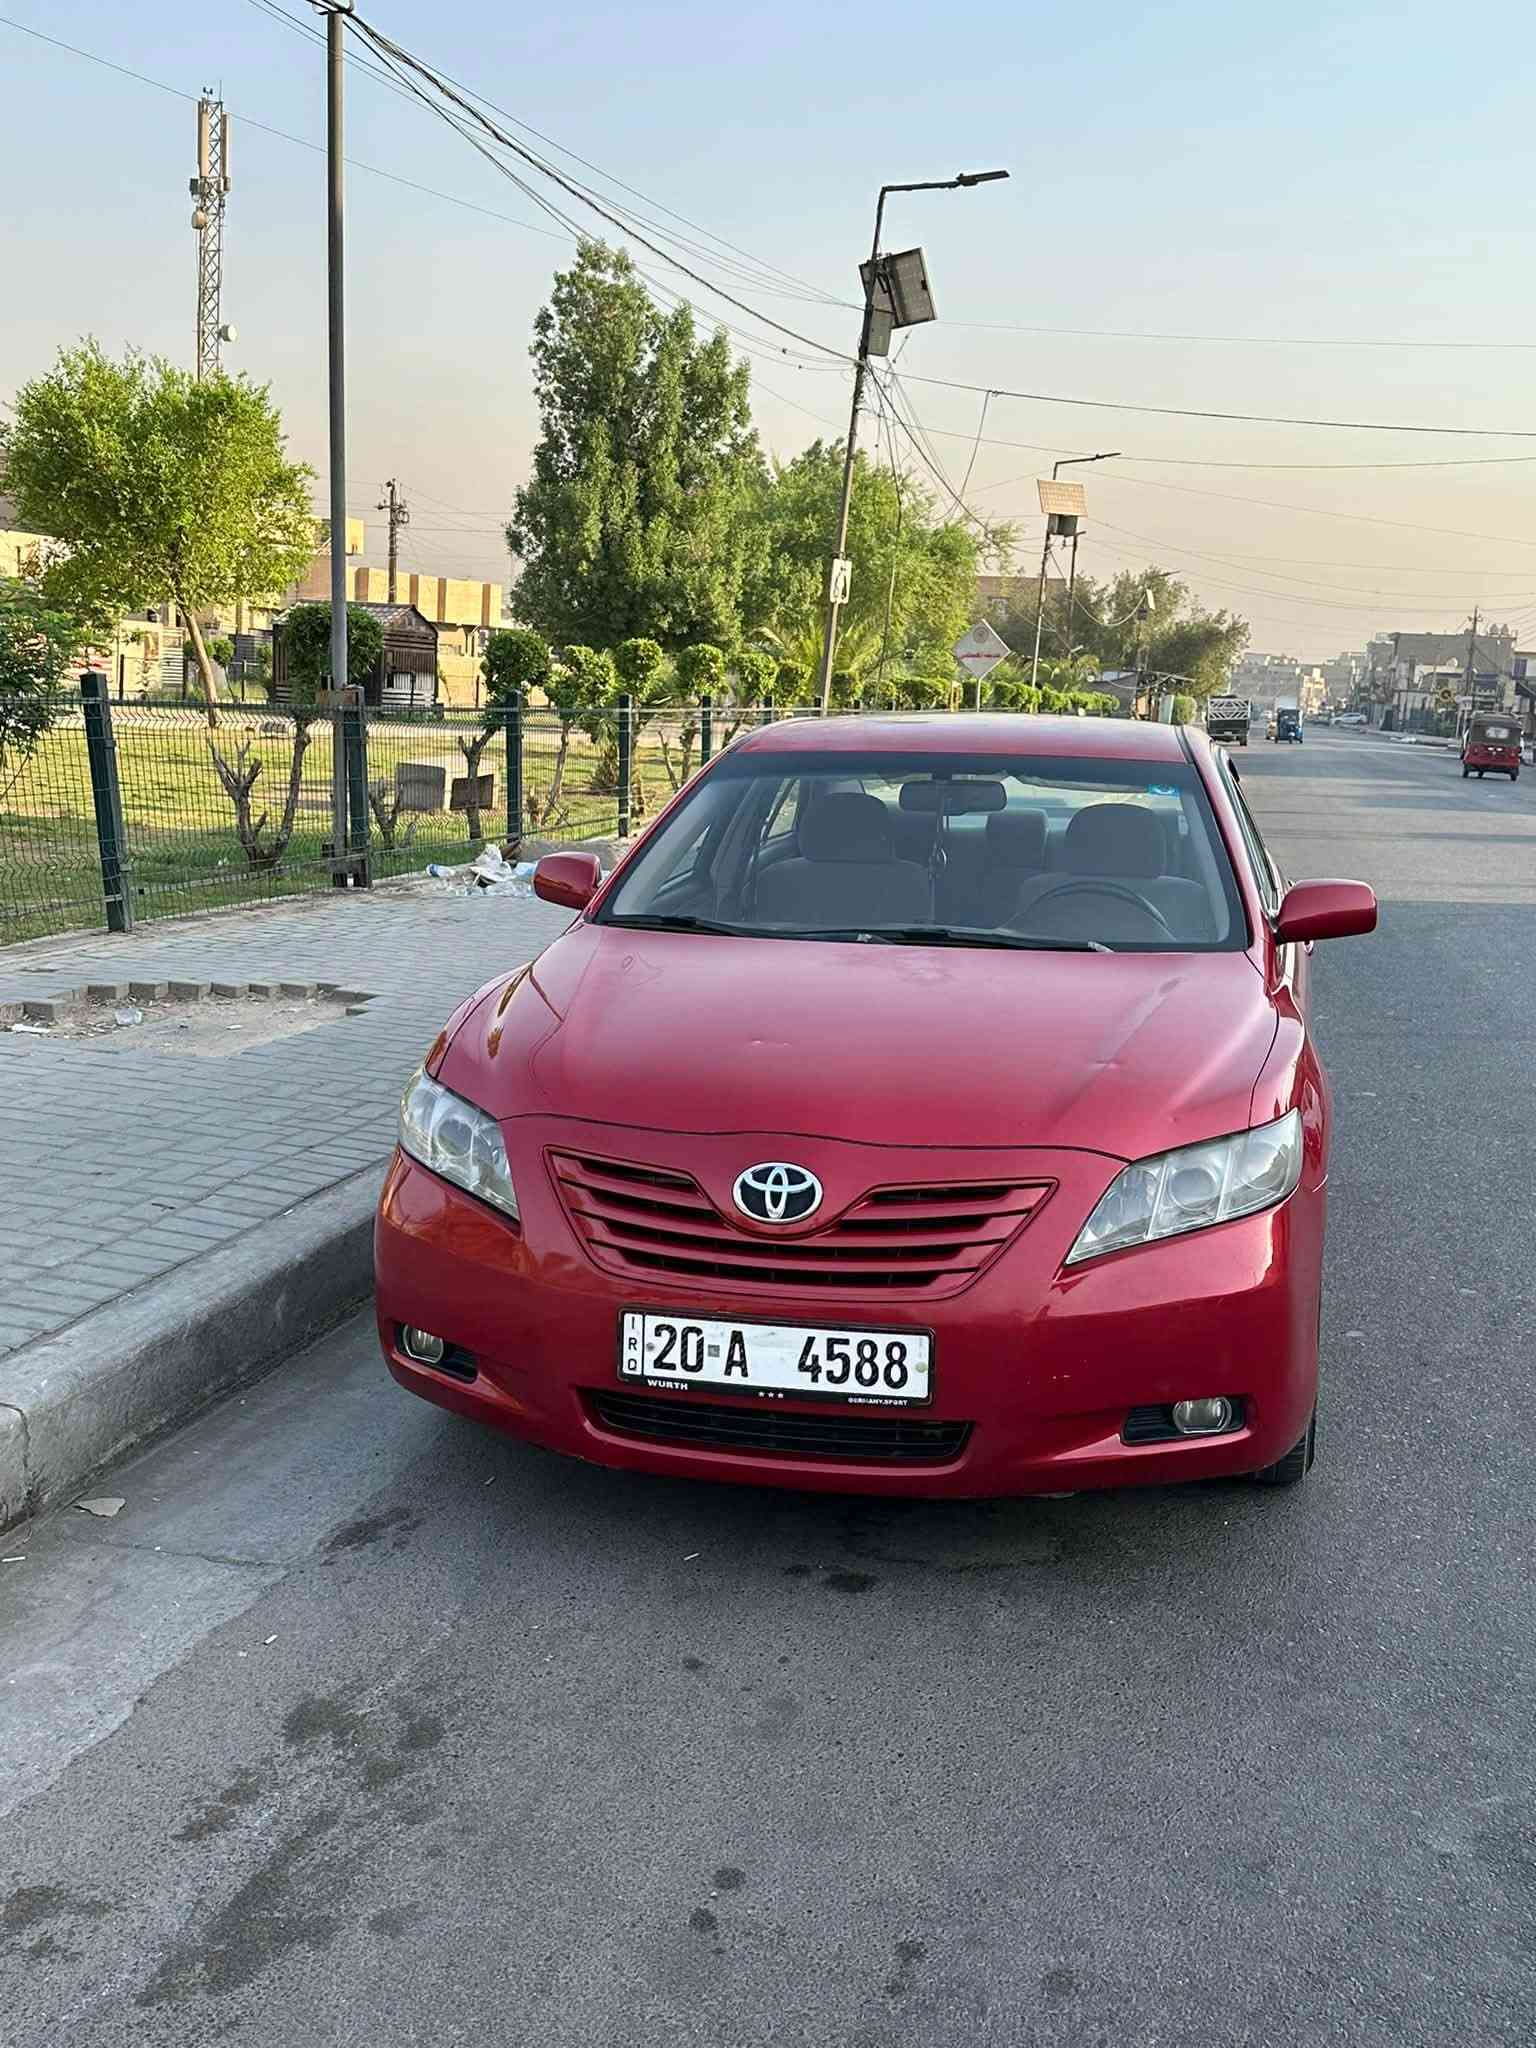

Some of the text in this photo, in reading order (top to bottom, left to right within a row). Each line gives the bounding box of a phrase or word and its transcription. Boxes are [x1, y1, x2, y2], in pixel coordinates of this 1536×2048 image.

[653, 1324, 908, 1389] 20 A 4588
[647, 1379, 688, 1390] WURTH
